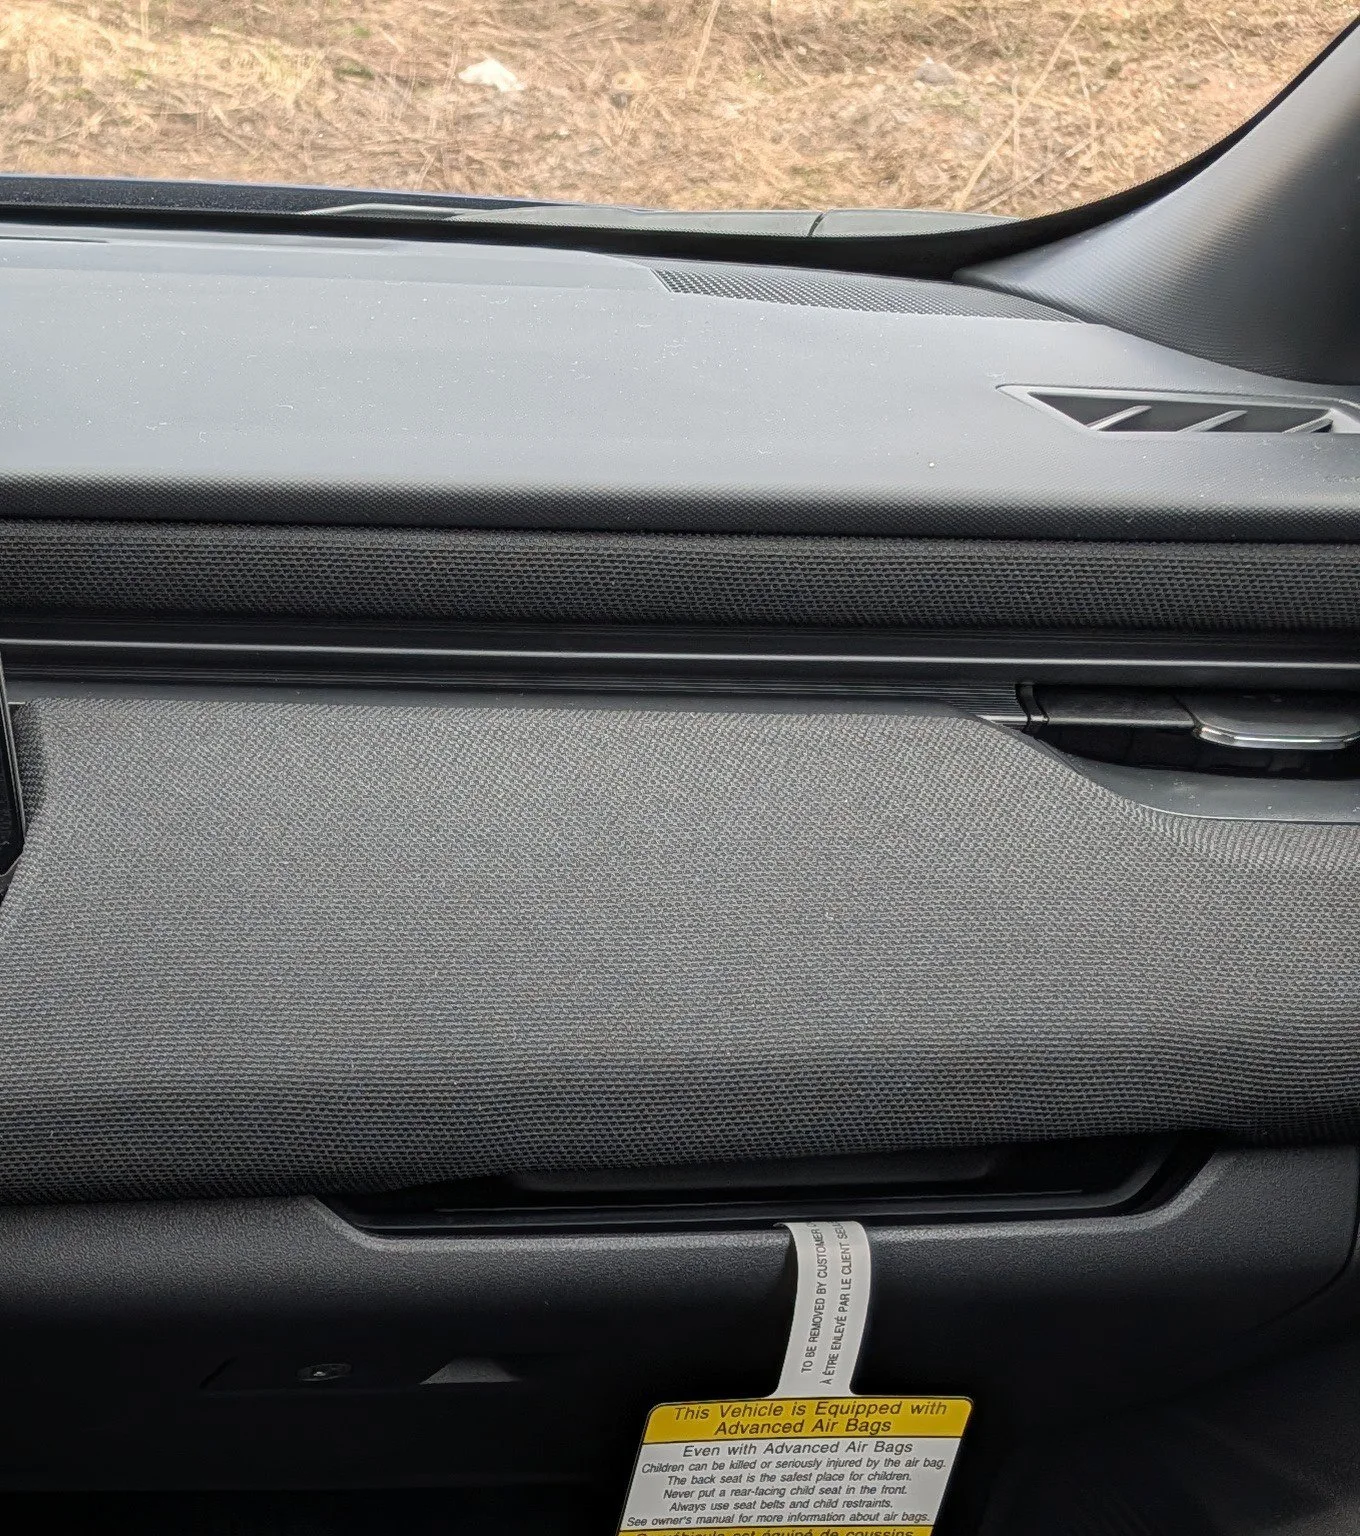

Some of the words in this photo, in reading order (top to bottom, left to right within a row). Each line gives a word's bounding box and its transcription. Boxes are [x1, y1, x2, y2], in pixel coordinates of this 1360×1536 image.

[839, 1242, 851, 1275] CLIENT
[817, 1282, 826, 1294] BY
[841, 1278, 851, 1290] LE
[838, 1294, 850, 1312] PAR
[808, 1298, 825, 1342] REMOVED
[831, 1316, 847, 1350] ENLEVÉ
[805, 1346, 817, 1357] BE
[801, 1361, 813, 1373] TO
[674, 1406, 709, 1420] This
[719, 1403, 783, 1418] Vehicle
[791, 1402, 806, 1416] is
[815, 1401, 902, 1418] Equipped
[910, 1402, 947, 1415] with
[714, 1420, 804, 1435] Advanced
[812, 1419, 838, 1432] Air
[845, 1418, 892, 1435] Bags
[683, 1445, 720, 1458] Even
[728, 1443, 756, 1455] with
[763, 1442, 840, 1454] Advanced
[845, 1441, 868, 1453] Air
[874, 1441, 913, 1455] Bags
[642, 1462, 684, 1473] Children
[689, 1463, 707, 1471] can
[712, 1461, 725, 1470] be
[730, 1460, 756, 1470] killed
[760, 1461, 772, 1469] or
[775, 1459, 822, 1470] seriously
[826, 1458, 862, 1469] injured
[866, 1458, 880, 1470] by
[884, 1458, 900, 1467] the
[905, 1458, 920, 1467] air
[923, 1458, 946, 1470] bag.
[668, 1476, 687, 1485] The
[691, 1474, 715, 1484] back
[720, 1474, 742, 1484] seat
[746, 1473, 755, 1483] is
[760, 1473, 776, 1482] the
[780, 1472, 812, 1482] safest
[816, 1472, 844, 1483] place
[849, 1472, 863, 1481] for
[868, 1471, 912, 1481] children.
[663, 1489, 693, 1499] Never
[698, 1488, 715, 1500] put
[730, 1487, 786, 1498] rear-facing
[790, 1486, 815, 1495] child
[818, 1485, 842, 1495] seat
[845, 1485, 855, 1495] in
[860, 1485, 877, 1494] the
[881, 1485, 907, 1494] front.
[669, 1502, 706, 1513] Always
[711, 1502, 729, 1510] use
[733, 1501, 755, 1510] seat
[760, 1500, 784, 1509] belts
[789, 1500, 809, 1509] and
[813, 1499, 837, 1508] child
[842, 1499, 893, 1508] restraints.
[627, 1517, 647, 1527] See
[652, 1516, 692, 1525] owner's
[696, 1514, 734, 1524] manual
[738, 1513, 752, 1522] for
[756, 1513, 783, 1523] more
[787, 1512, 845, 1522] information
[849, 1512, 880, 1521] about
[884, 1512, 898, 1521] air
[901, 1512, 930, 1523] bags.
